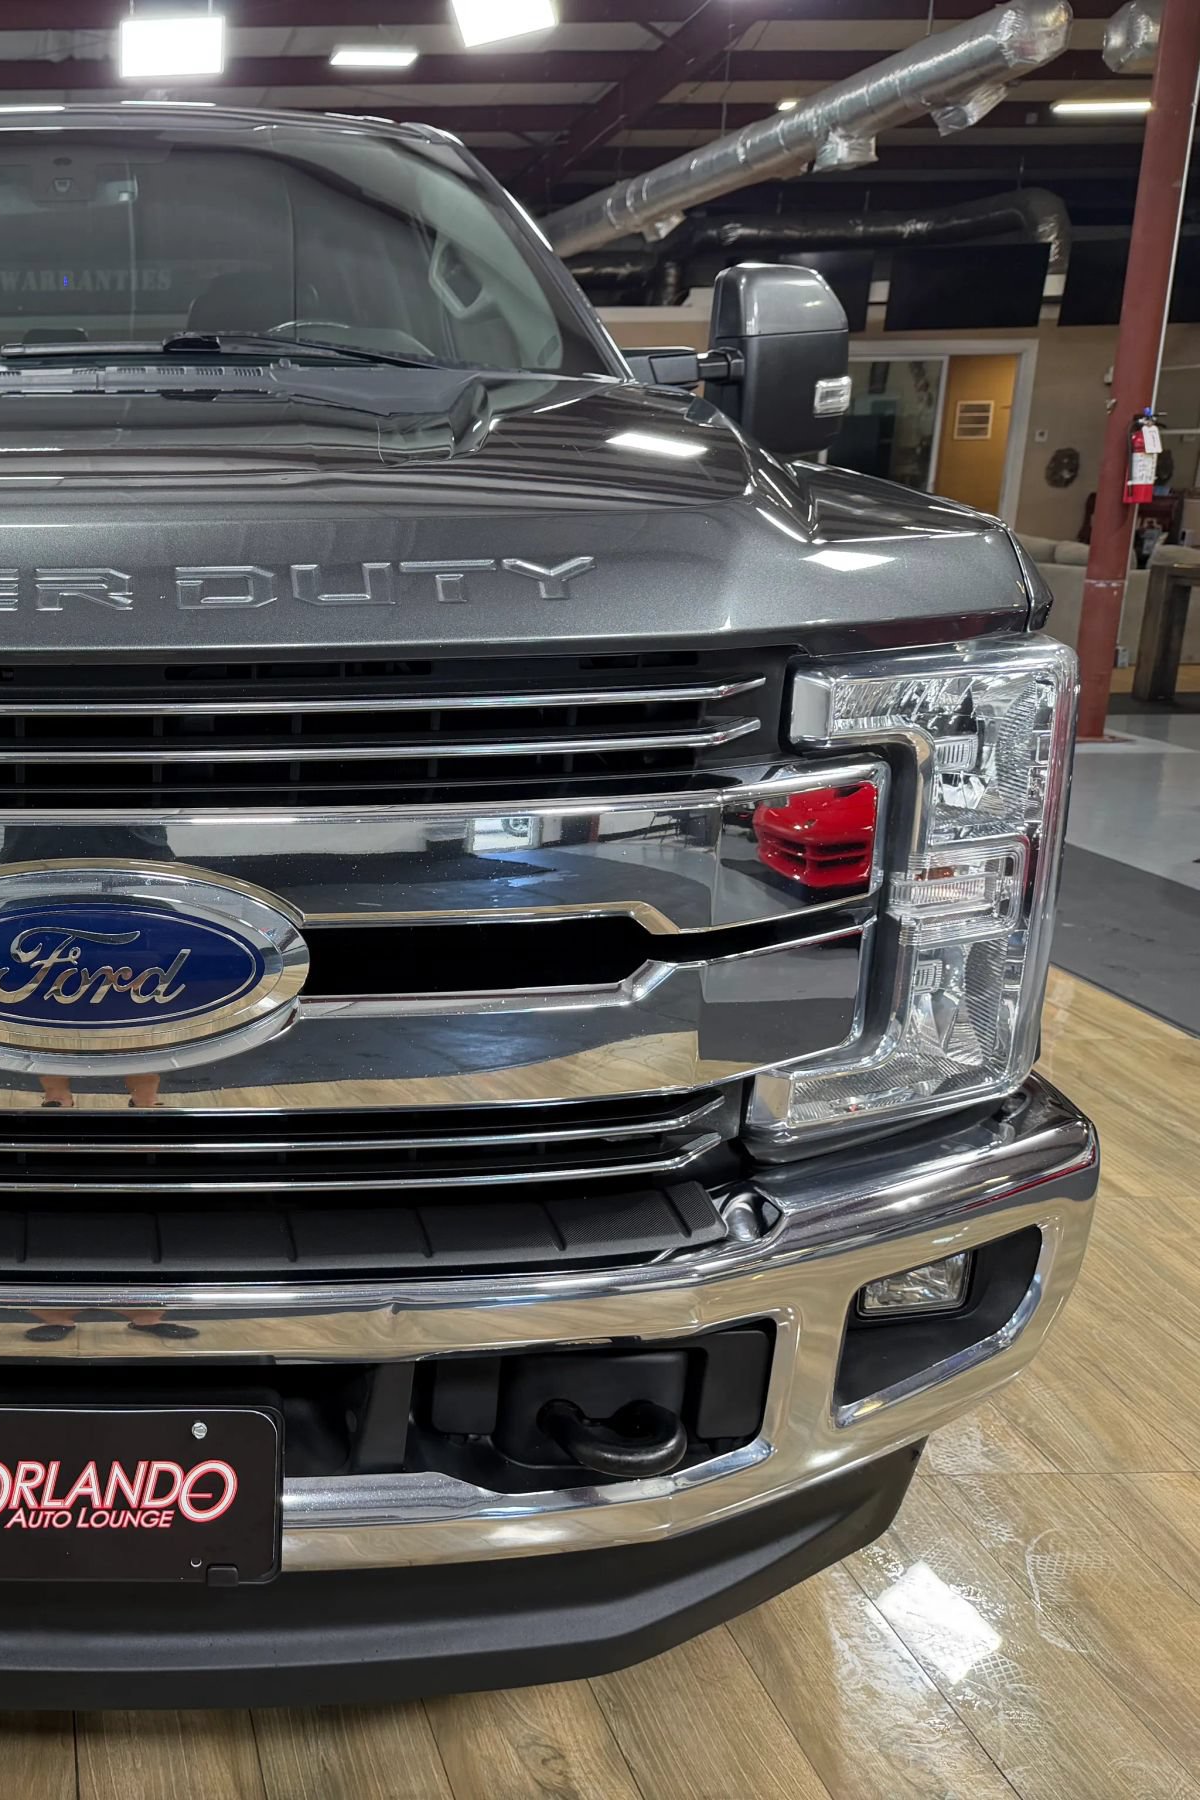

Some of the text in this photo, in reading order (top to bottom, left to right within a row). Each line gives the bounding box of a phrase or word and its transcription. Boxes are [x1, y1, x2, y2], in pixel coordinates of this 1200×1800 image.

[0, 269, 172, 292] WARRANTIES
[175, 556, 596, 609] DUTY
[4, 1507, 175, 1529] AUTO LOUNGE
